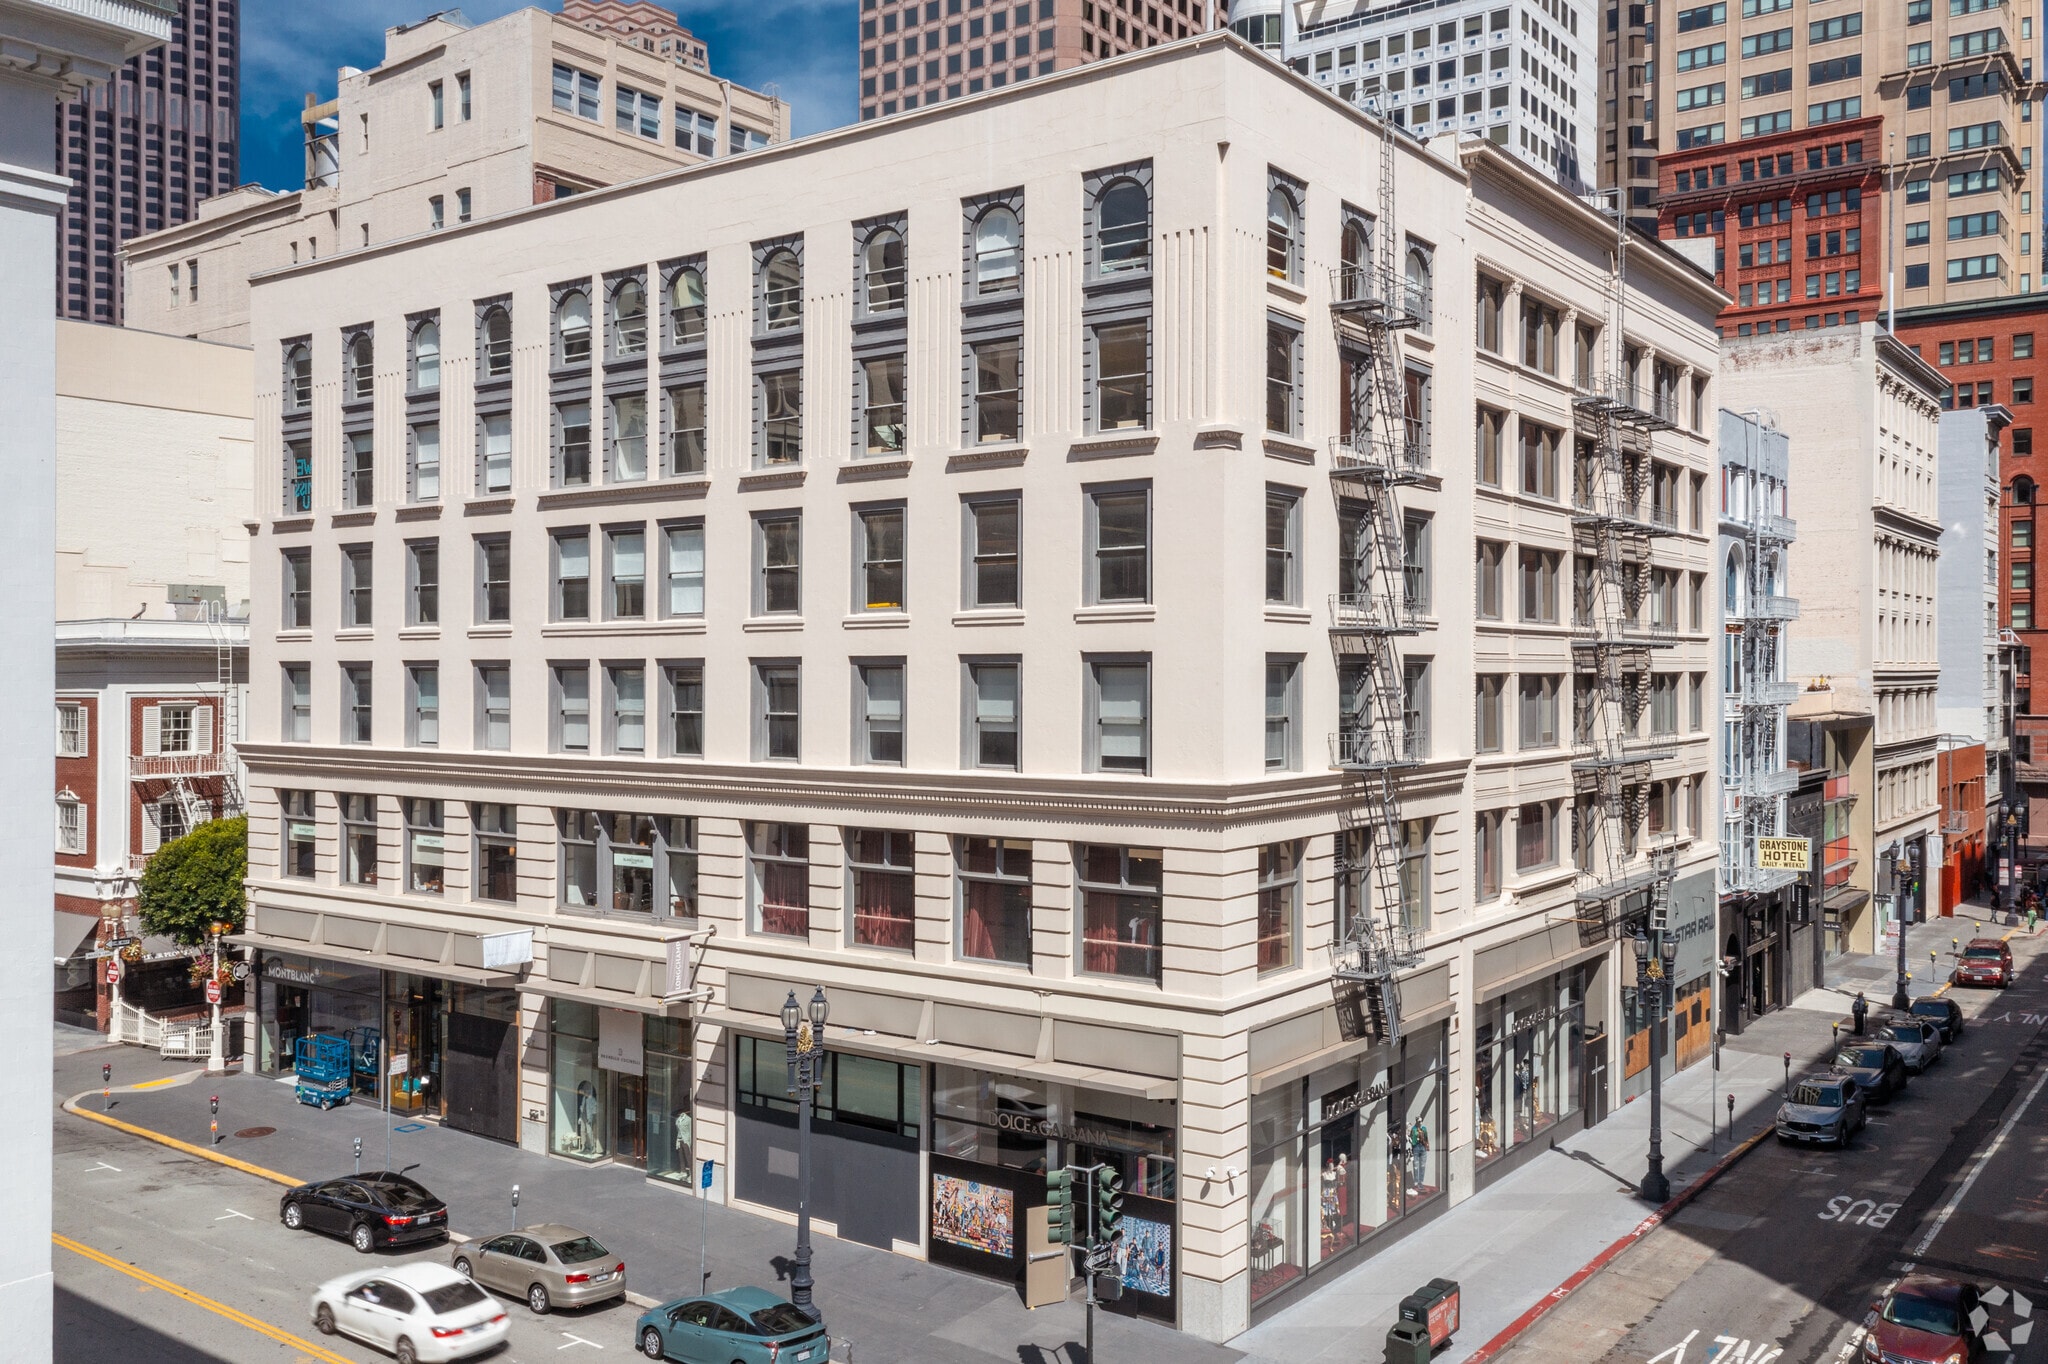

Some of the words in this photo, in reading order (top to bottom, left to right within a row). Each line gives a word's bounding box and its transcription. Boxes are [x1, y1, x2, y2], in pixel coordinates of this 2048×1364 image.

[1759, 840, 1808, 851] GRAYSTONE
[1763, 851, 1804, 861] HOTEL
[268, 966, 315, 983] MONTBLANC
[1817, 1195, 1902, 1228] BUS
